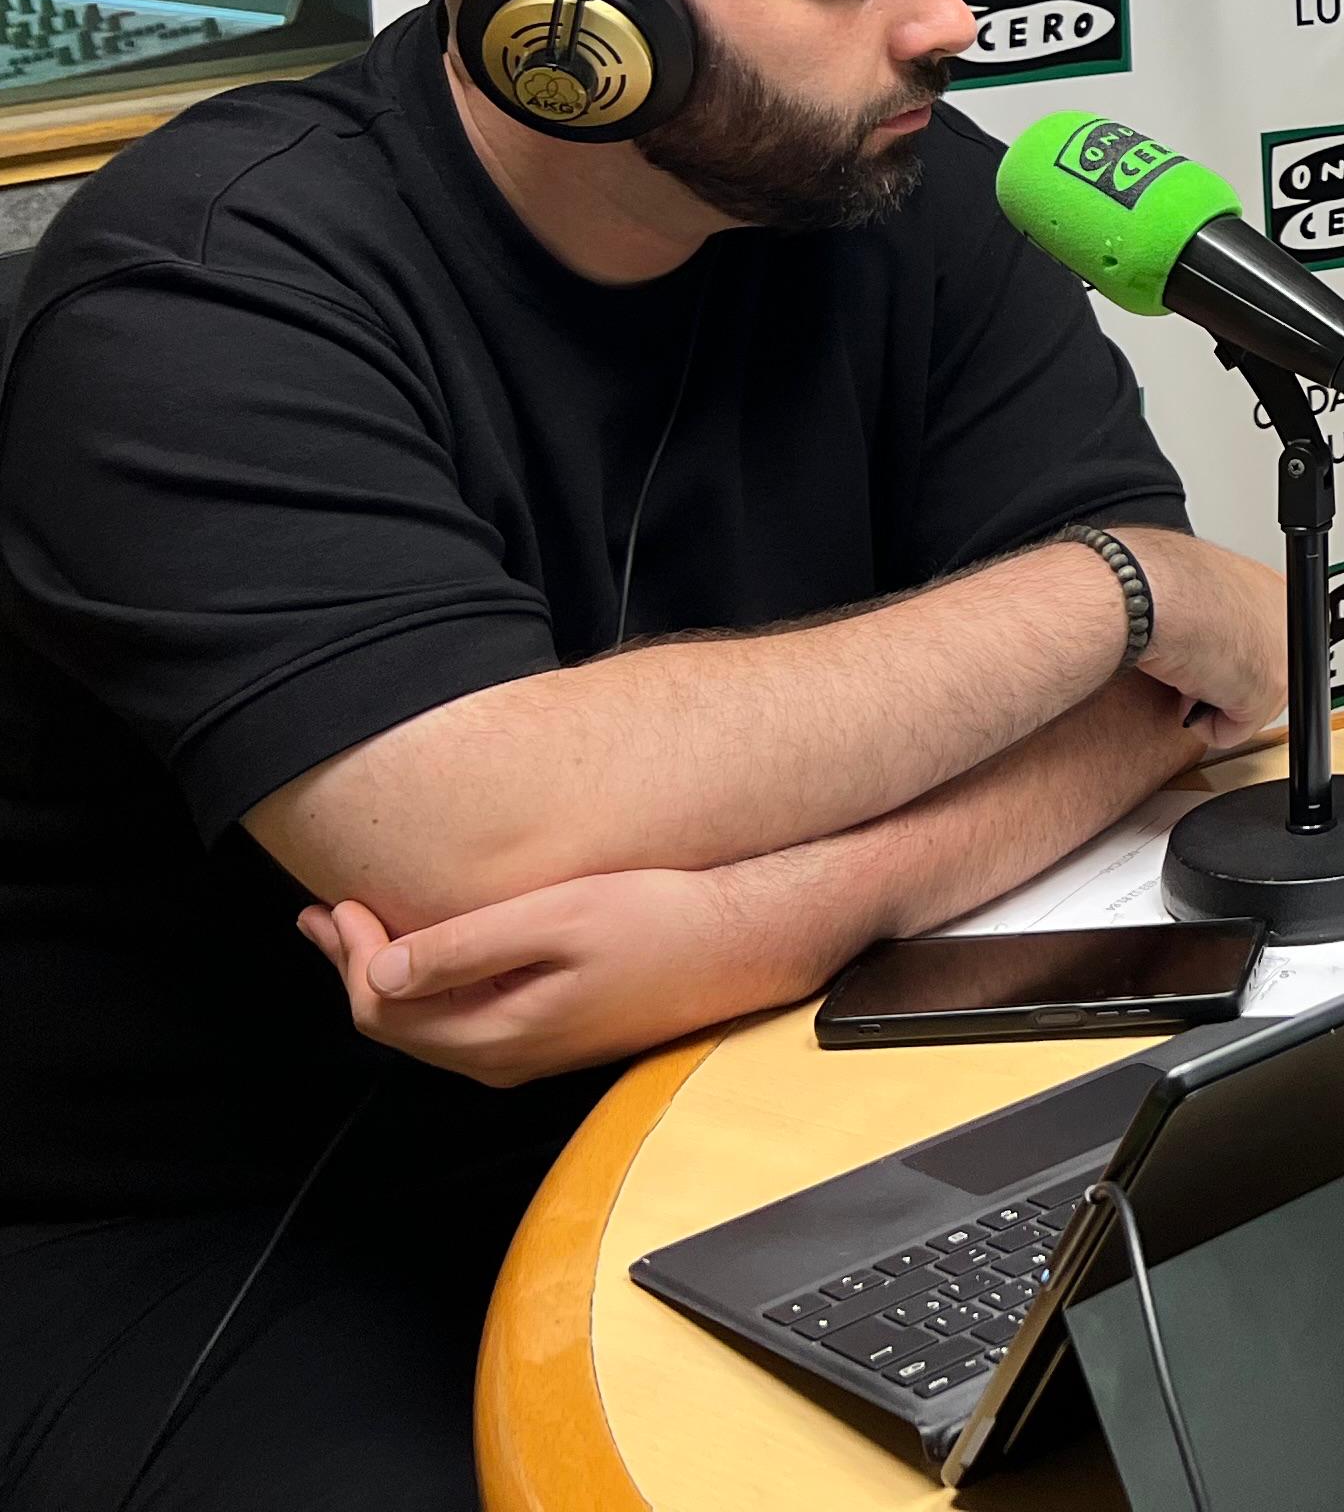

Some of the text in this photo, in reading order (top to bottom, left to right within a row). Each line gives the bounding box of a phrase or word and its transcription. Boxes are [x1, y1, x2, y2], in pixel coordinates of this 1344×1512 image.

[976, 11, 1094, 51] CERO
[526, 97, 575, 114] AKG
[1085, 126, 1136, 162] OND
[1121, 143, 1174, 176] CER
